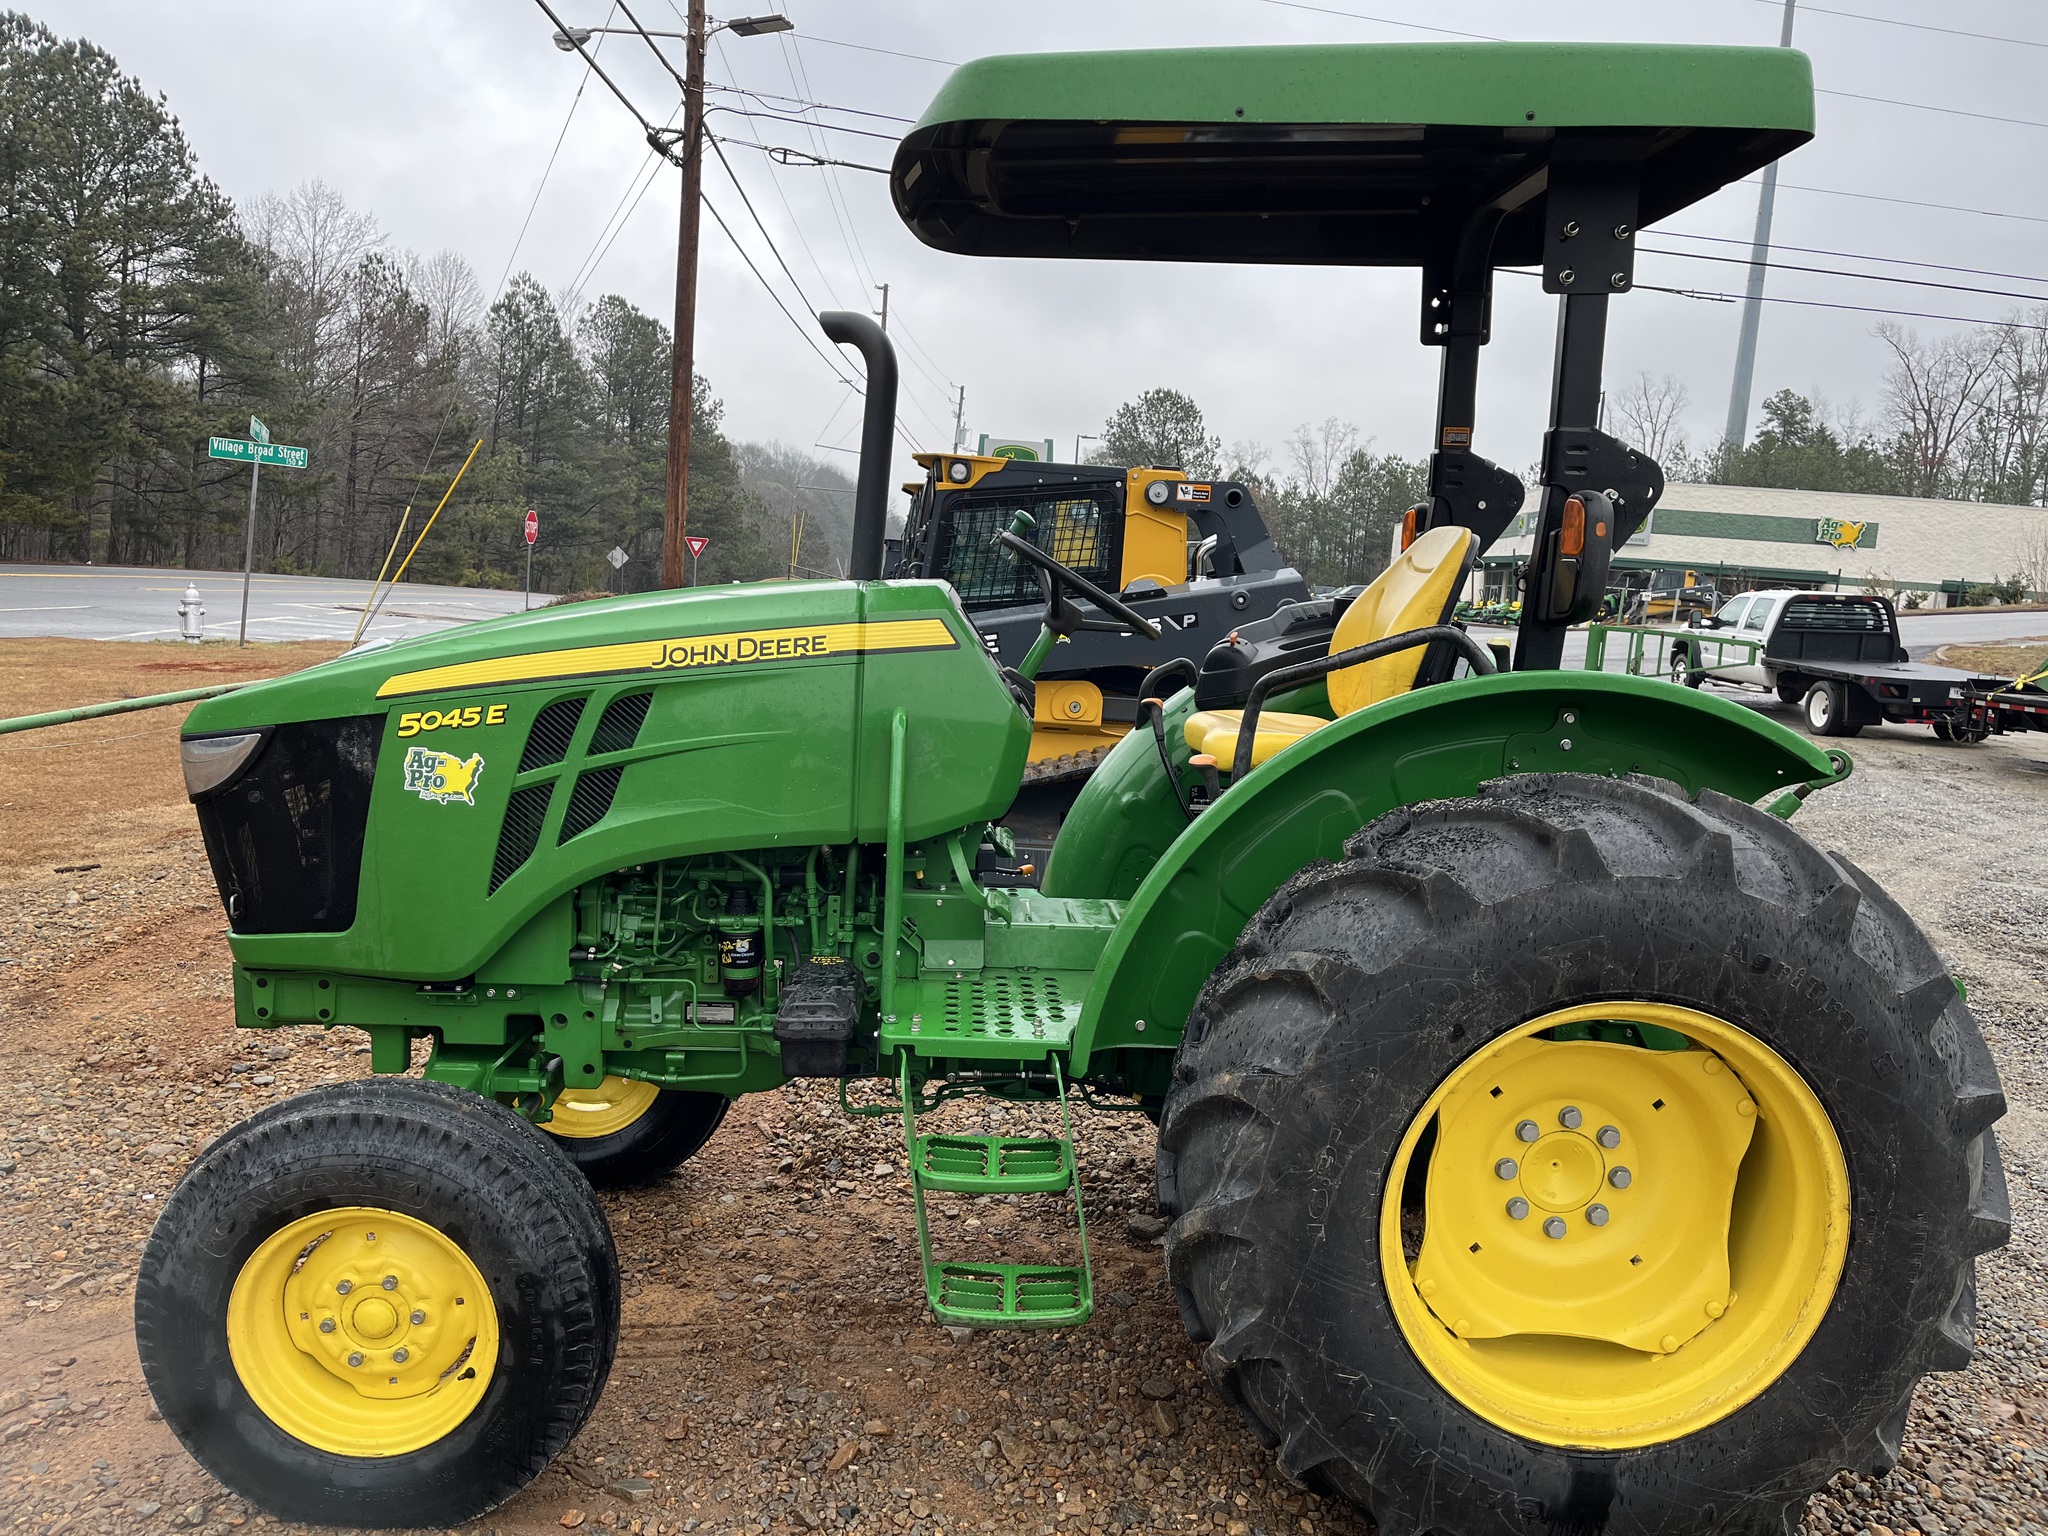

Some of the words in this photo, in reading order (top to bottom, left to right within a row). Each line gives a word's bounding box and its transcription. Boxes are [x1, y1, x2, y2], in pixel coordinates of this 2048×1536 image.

[213, 440, 243, 455] Village
[248, 443, 273, 456] Broad
[278, 447, 304, 460] Street
[525, 520, 538, 533] STOP
[1820, 529, 1842, 540] Pro
[651, 643, 729, 666] JOHN
[736, 634, 827, 659] DEERE
[397, 706, 482, 737] 5045
[486, 704, 508, 724] E
[408, 749, 445, 773] Ag-
[408, 769, 446, 790] Pro
